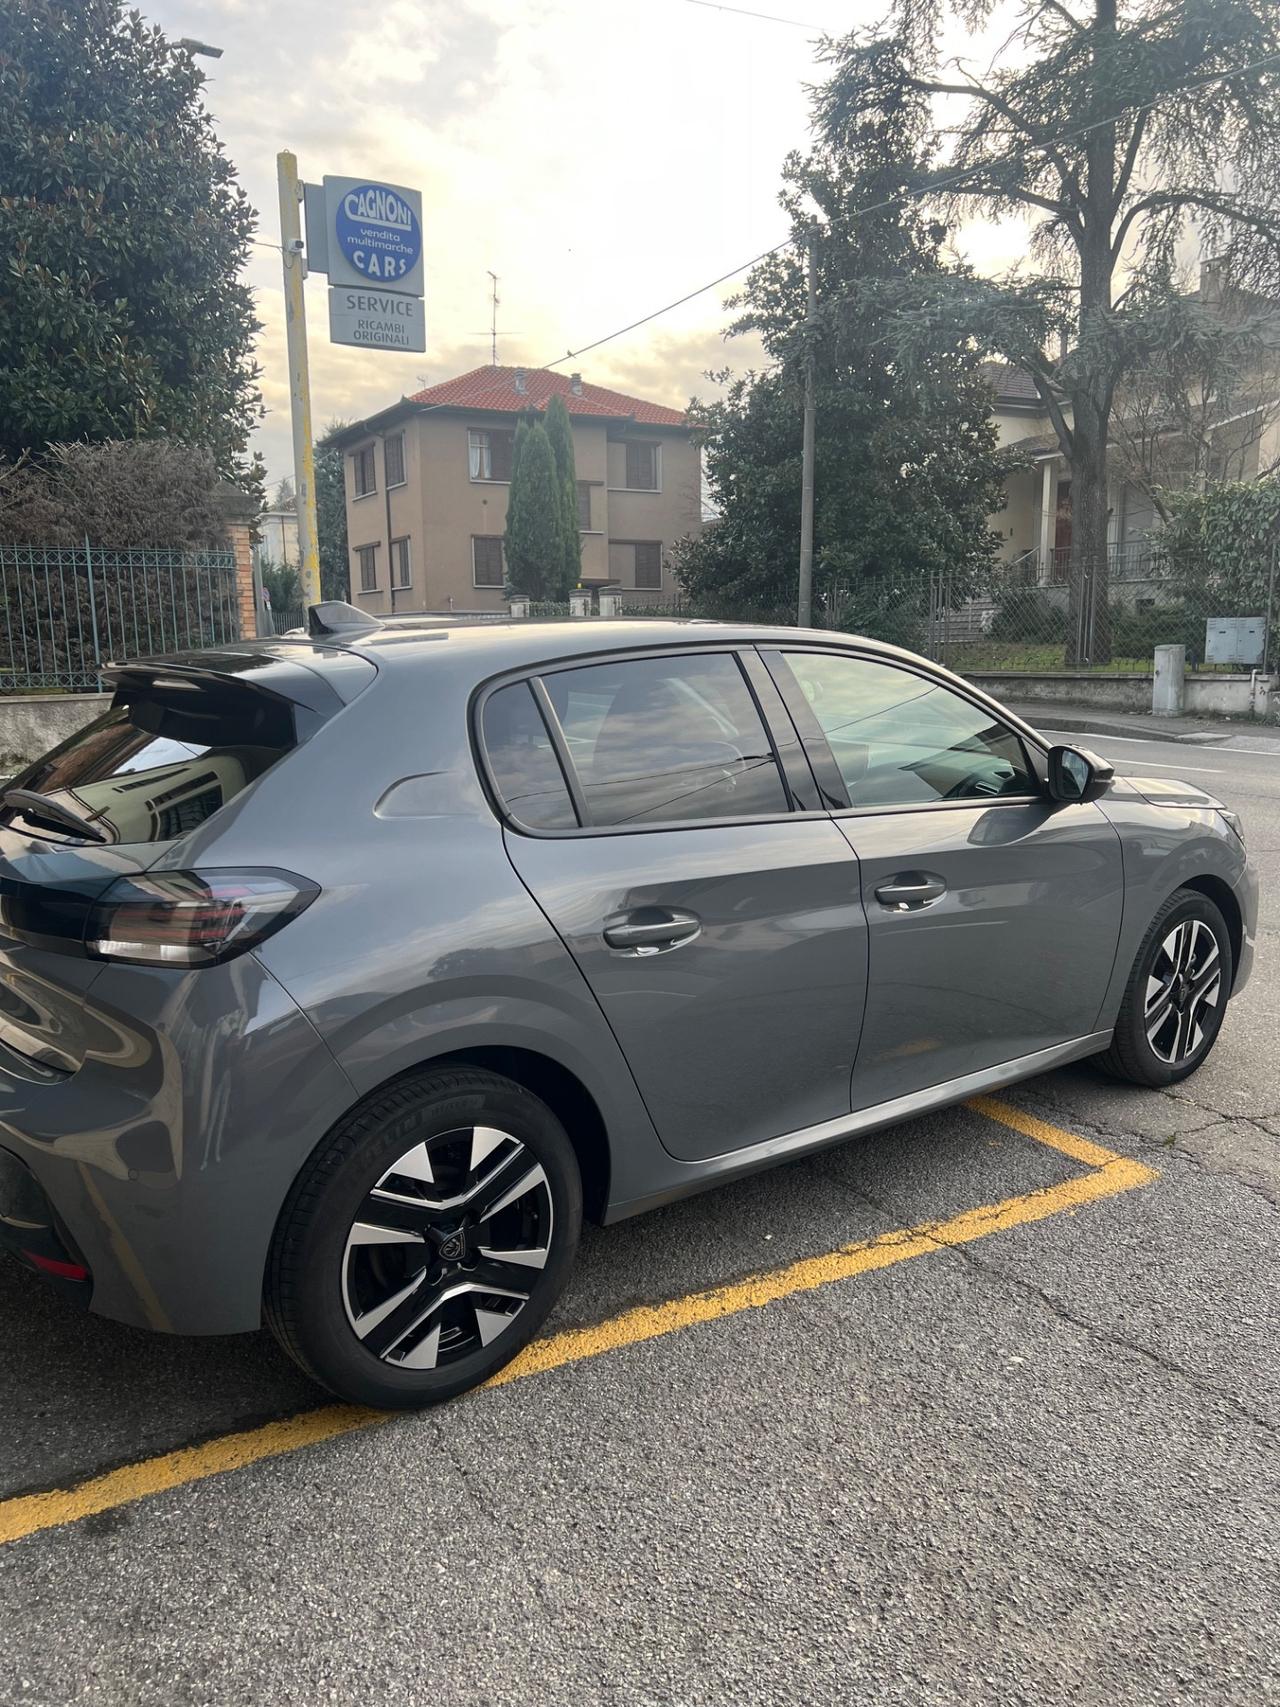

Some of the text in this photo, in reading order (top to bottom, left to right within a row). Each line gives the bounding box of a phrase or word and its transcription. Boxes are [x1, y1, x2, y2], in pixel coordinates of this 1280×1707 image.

[344, 190, 411, 231] CAGNONI
[361, 228, 400, 242] vendita
[347, 236, 413, 254] multimarche
[353, 251, 406, 277] CARS
[346, 295, 413, 316] SERVICE
[358, 319, 404, 333] RICAMBI
[353, 331, 409, 345] ORIGINALI
